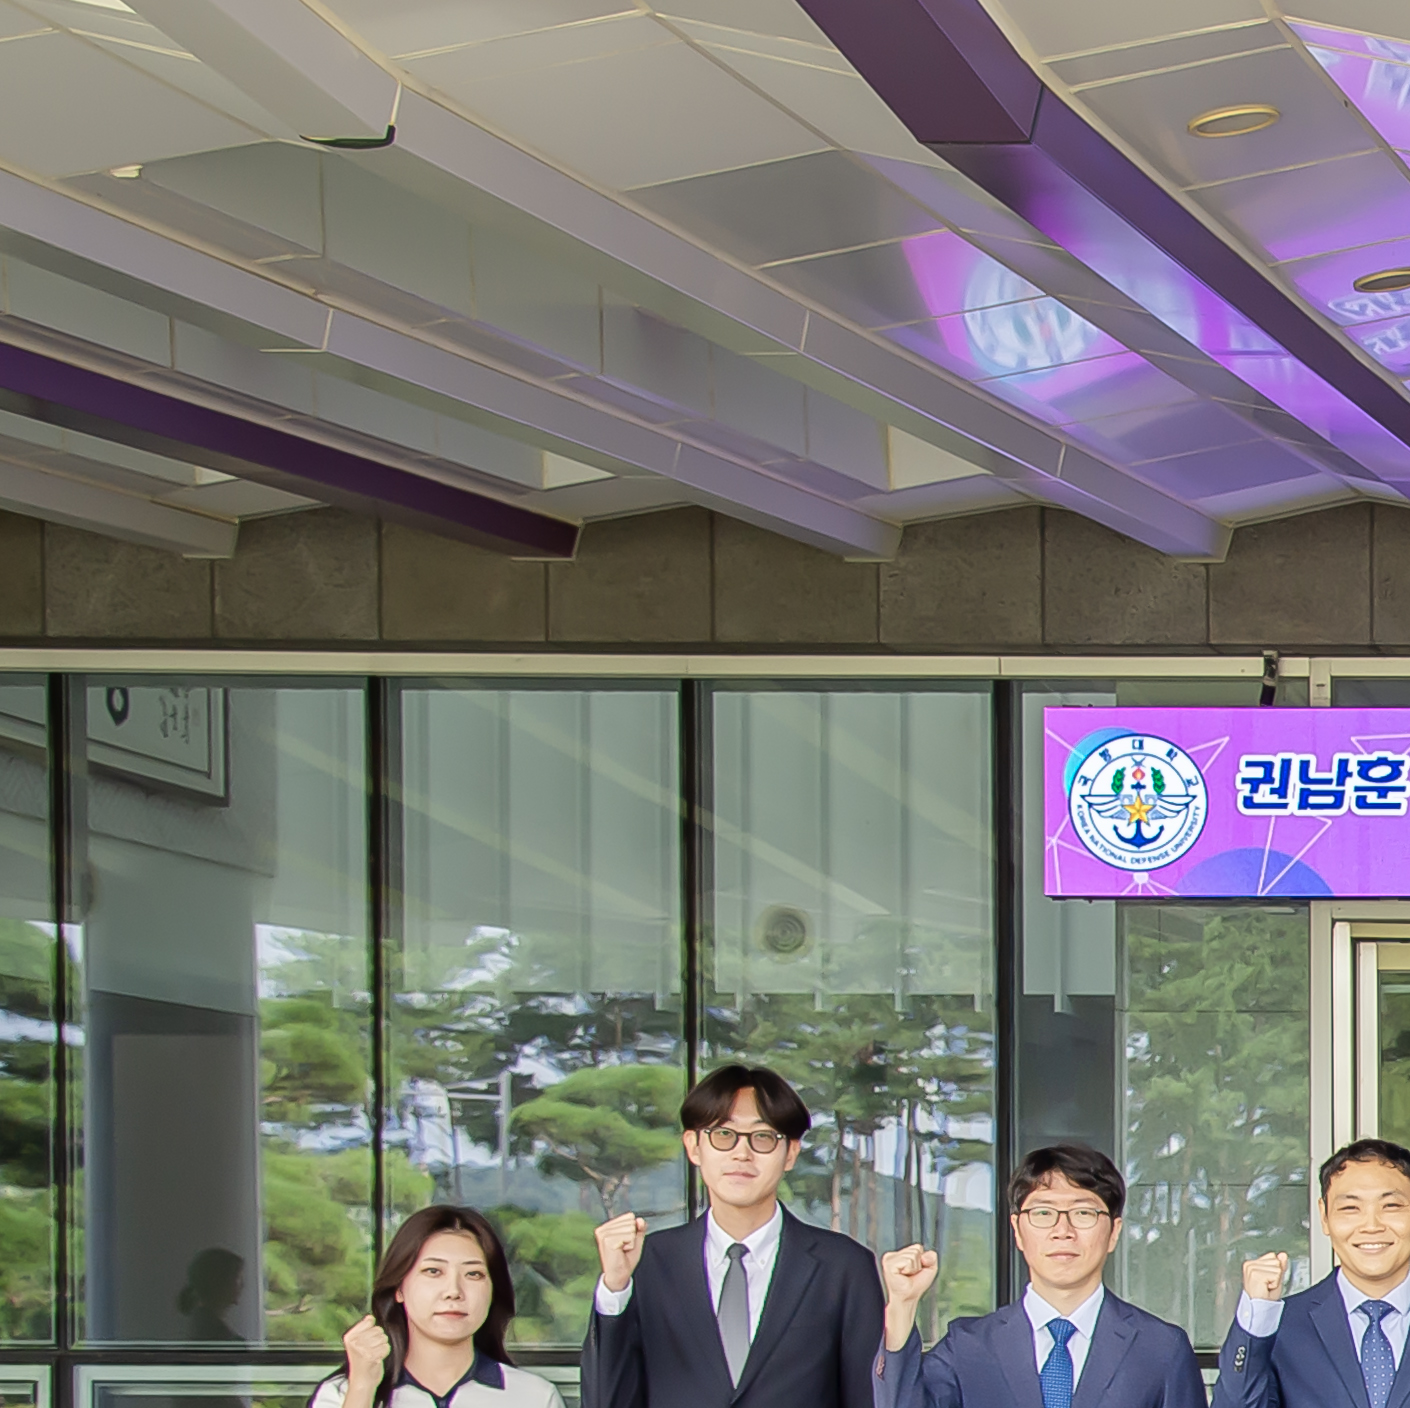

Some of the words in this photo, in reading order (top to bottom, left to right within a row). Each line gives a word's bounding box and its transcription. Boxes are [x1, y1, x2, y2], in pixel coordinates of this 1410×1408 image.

[1240, 756, 1407, 811] 권남훈
[1076, 803, 1090, 833] KOREA
[1089, 833, 1128, 864] NATIONAL
[1130, 850, 1171, 865] DEFENSE
